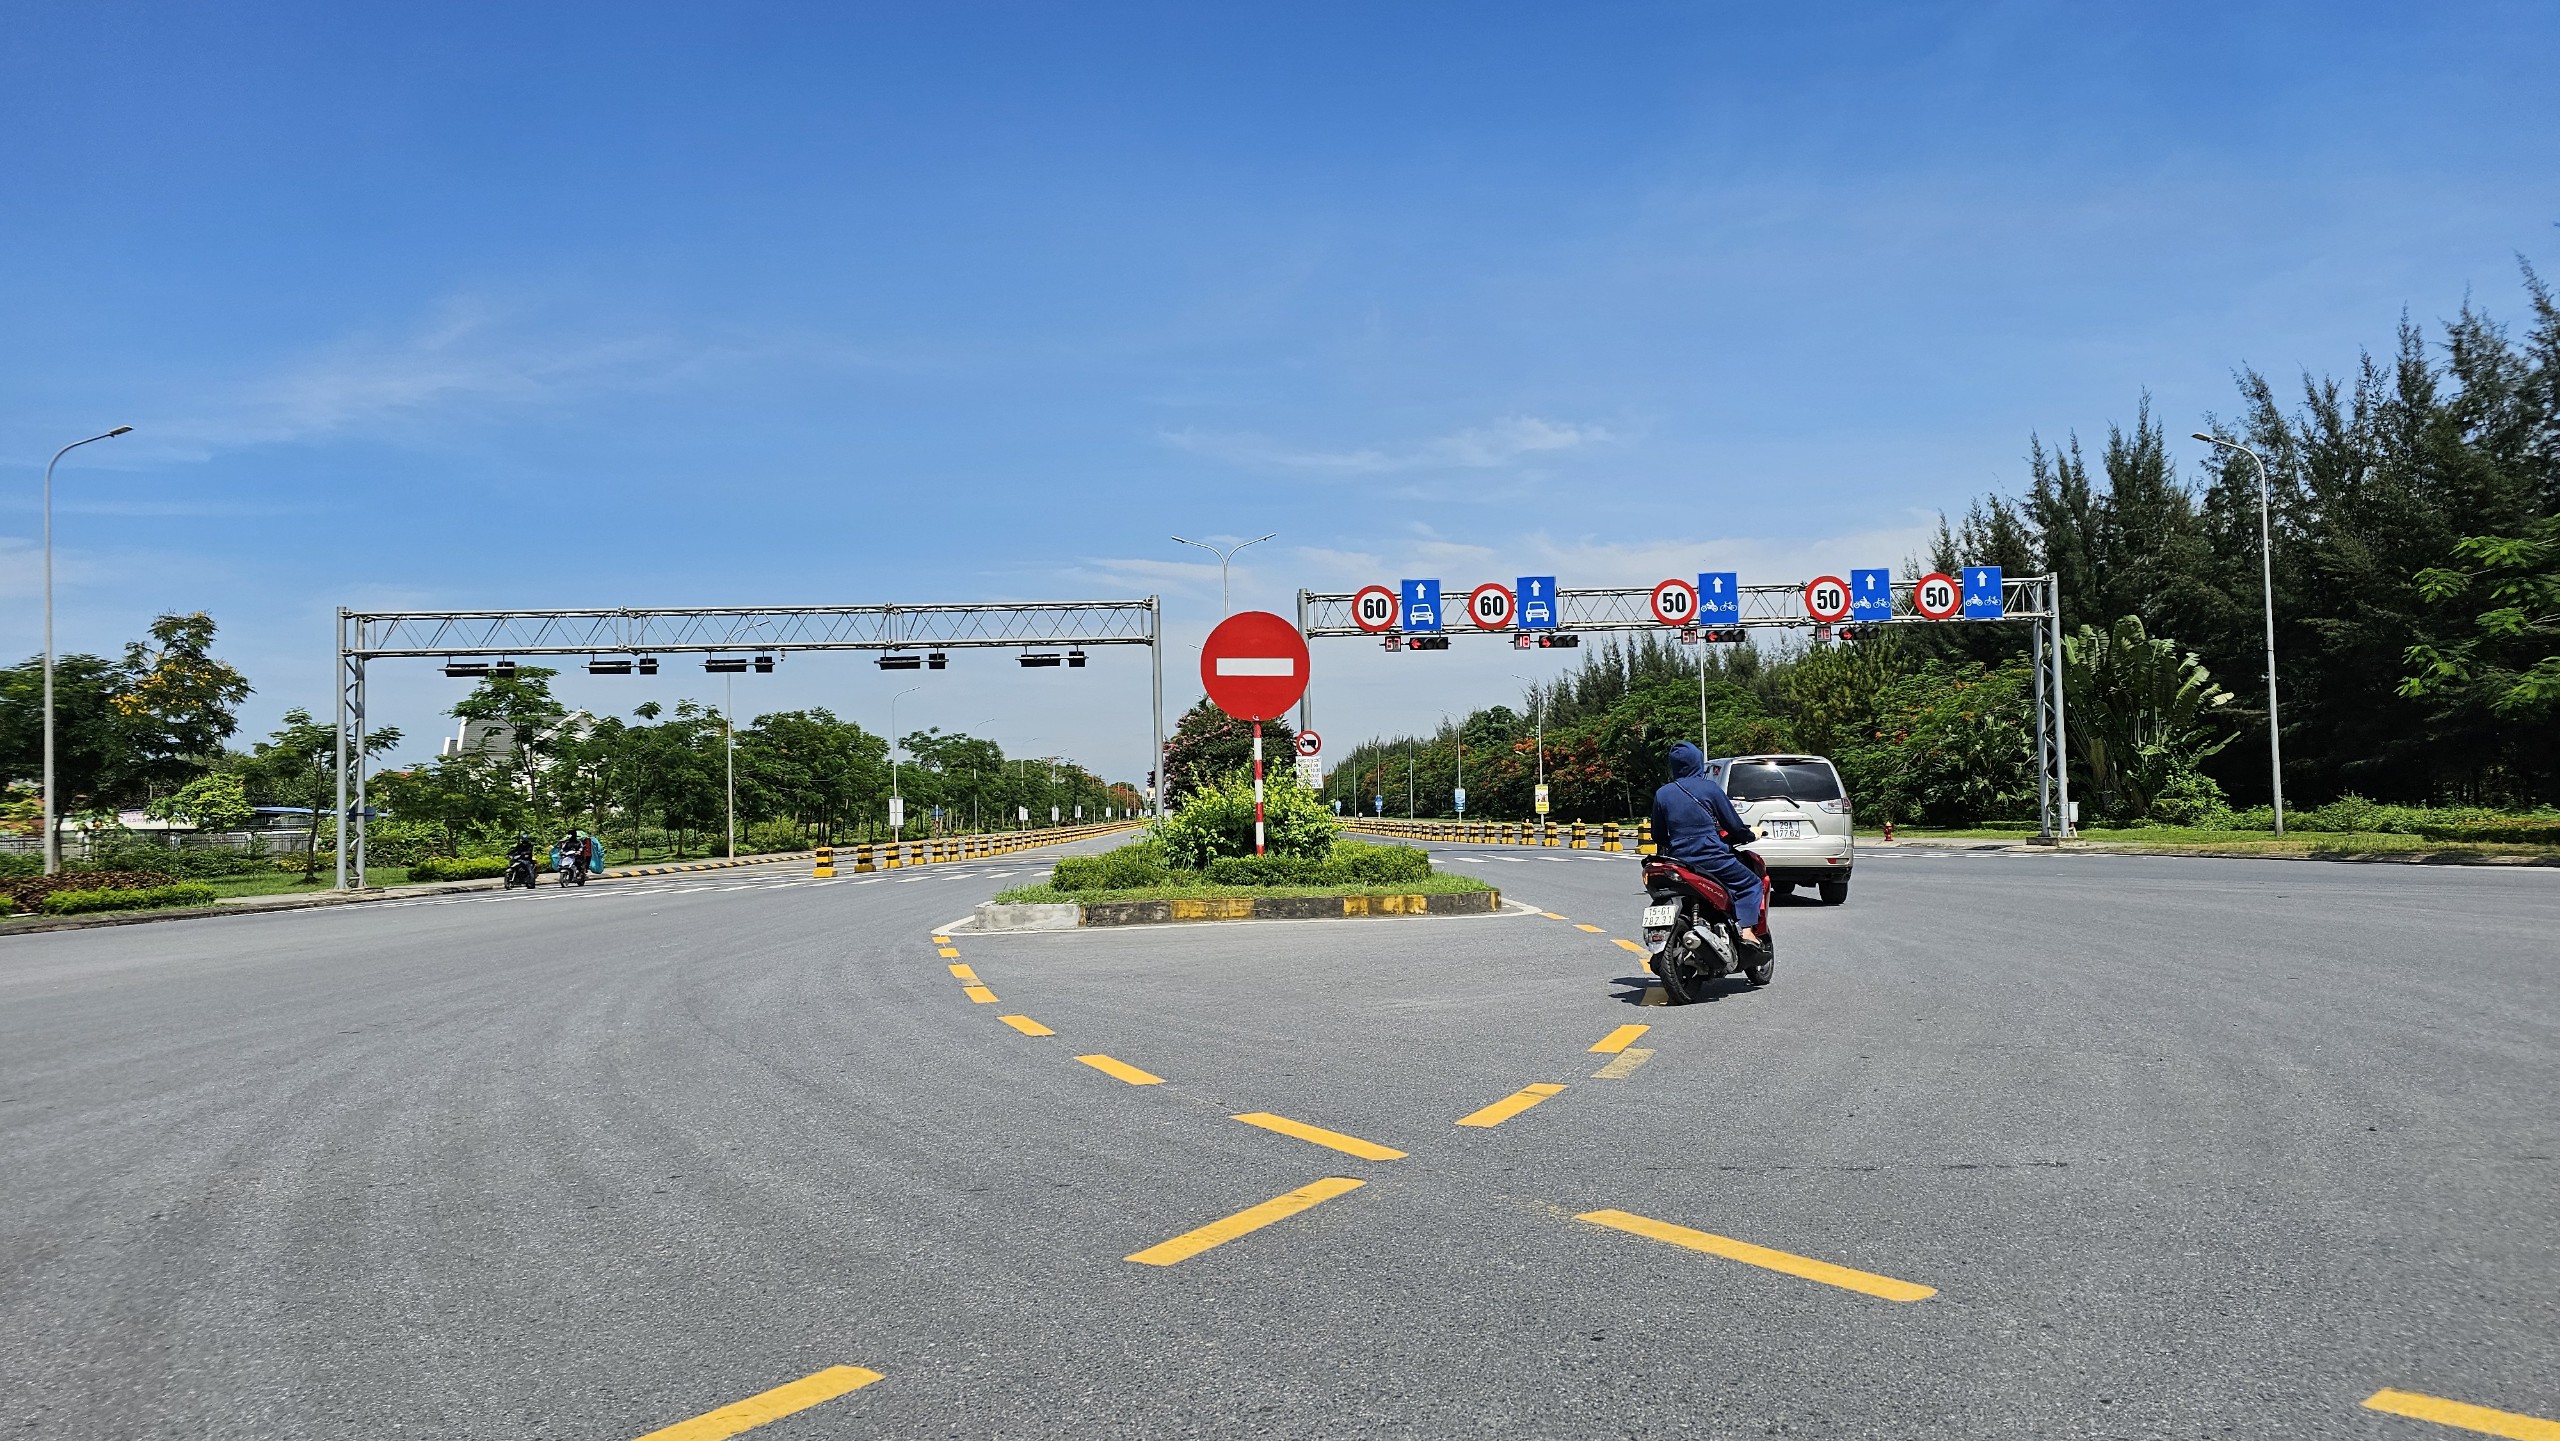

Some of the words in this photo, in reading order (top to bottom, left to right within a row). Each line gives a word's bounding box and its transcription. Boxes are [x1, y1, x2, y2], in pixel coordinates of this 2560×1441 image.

[1480, 596, 1504, 617] 60
[1662, 592, 1687, 613] 50
[1816, 589, 1840, 610] 50
[1925, 586, 1950, 608] 50
[1363, 598, 1387, 619] 60
[1779, 821, 1794, 829] 29A
